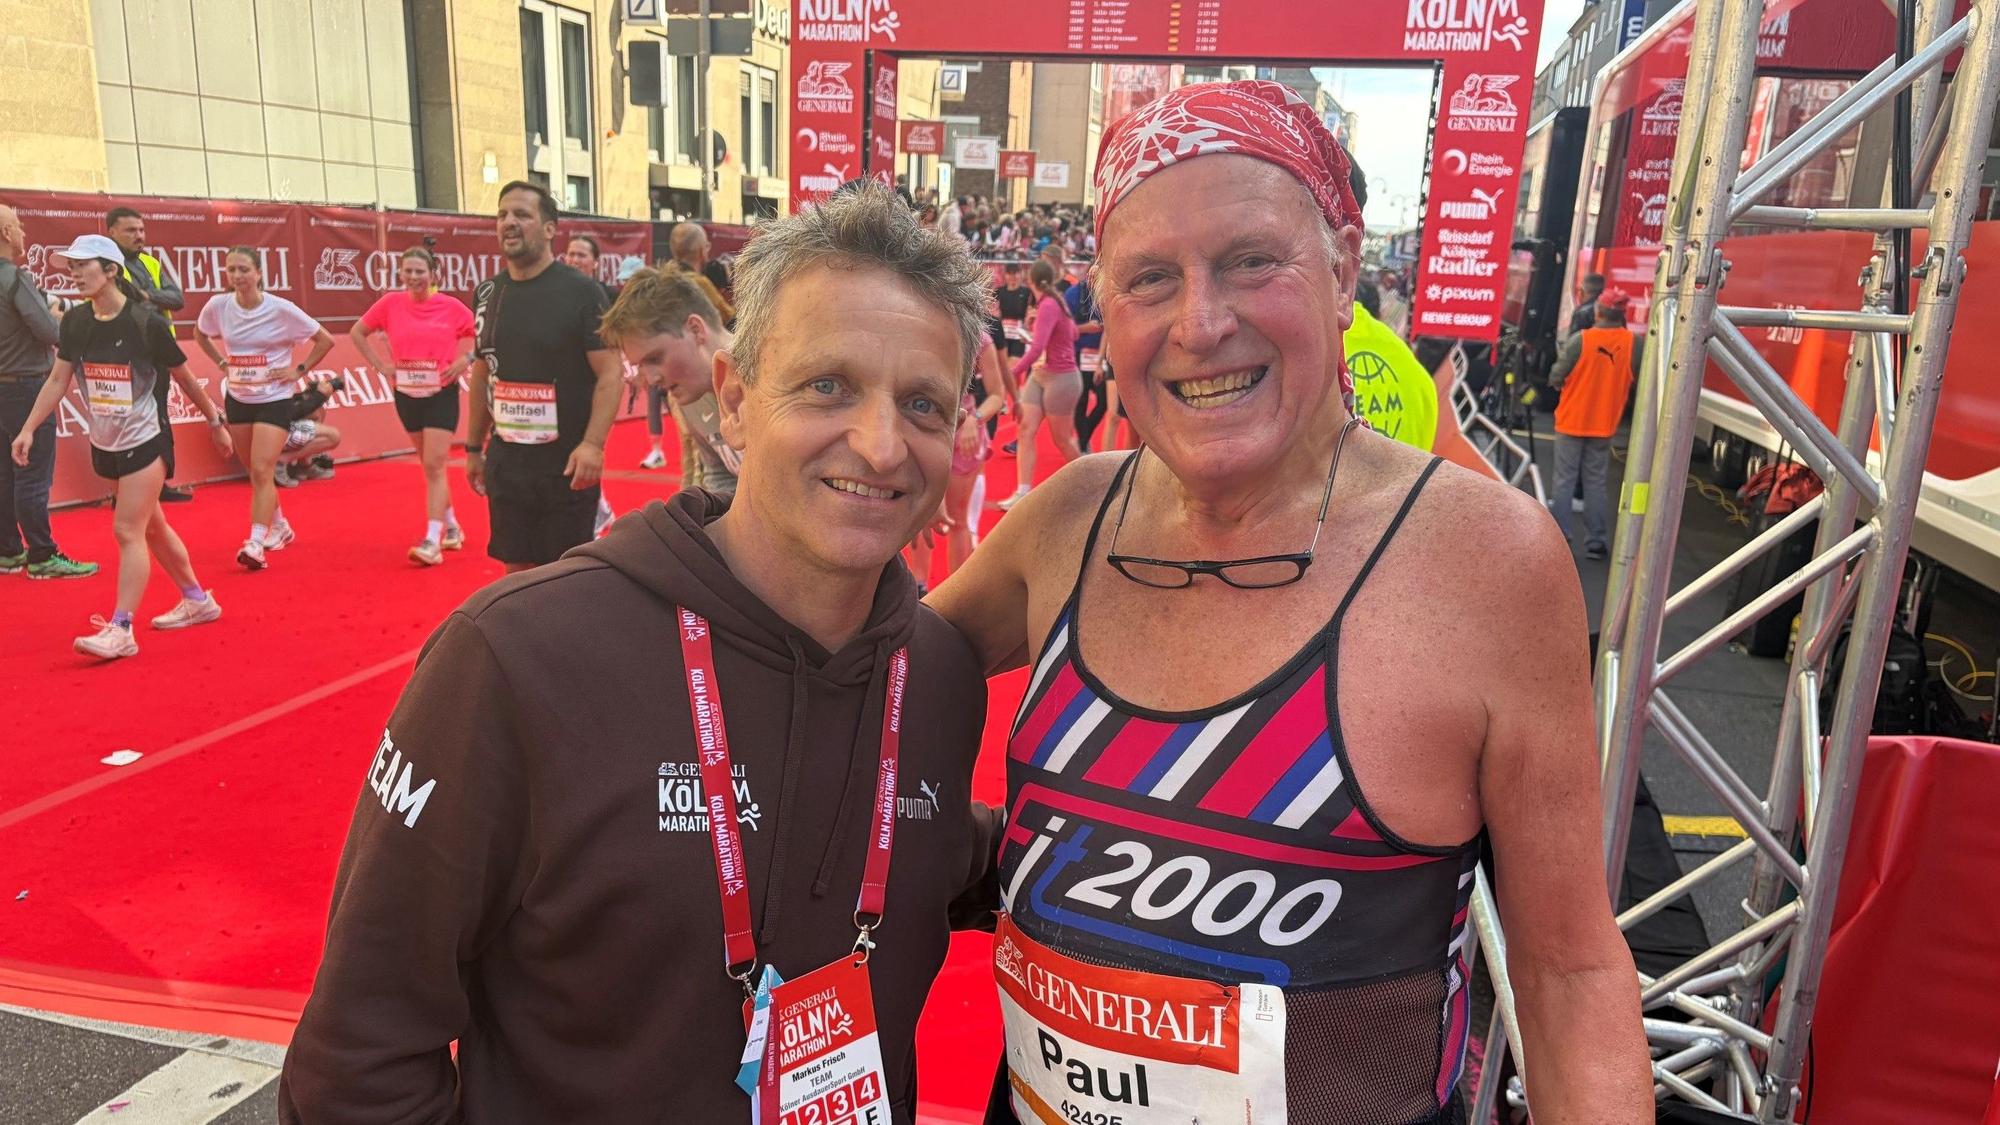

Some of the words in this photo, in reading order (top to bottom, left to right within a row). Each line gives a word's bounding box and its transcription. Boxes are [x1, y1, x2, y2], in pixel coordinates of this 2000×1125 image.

[798, 23, 863, 41] MARATHON
[1404, 31, 1482, 51] MARATHON
[1447, 117, 1517, 132] GENERALI
[1468, 164, 1514, 178] Energie
[1440, 201, 1489, 220] PUMA
[1428, 256, 1498, 276] Radler
[1441, 287, 1495, 303] pixum
[95, 380, 116, 393] Miku
[500, 402, 546, 417] Raffael
[1355, 392, 1403, 416] EAM
[690, 668, 704, 694] KÖLN
[893, 657, 907, 708] MARATHON
[695, 695, 715, 750] MARATHON
[712, 712, 724, 748] GENERALI
[367, 727, 437, 829] TEAM
[659, 778, 708, 813] KÖL
[709, 795, 727, 822] KÖLN
[882, 771, 896, 824] MARATHON
[896, 797, 932, 820] PUMA
[659, 815, 711, 832] MARATH
[715, 823, 736, 882] MARATHON
[784, 986, 837, 1017] GENERALI
[1026, 961, 1227, 1049] GENERALI
[792, 1060, 821, 1083] Markus
[822, 1051, 846, 1069] Frisch
[810, 1070, 833, 1088] TEAM
[1037, 1026, 1150, 1108] Paul
[802, 1076, 847, 1103] AusdauerSport
[805, 1103, 820, 1125] 2
[832, 1090, 849, 1116] 3
[860, 1076, 876, 1101] 4
